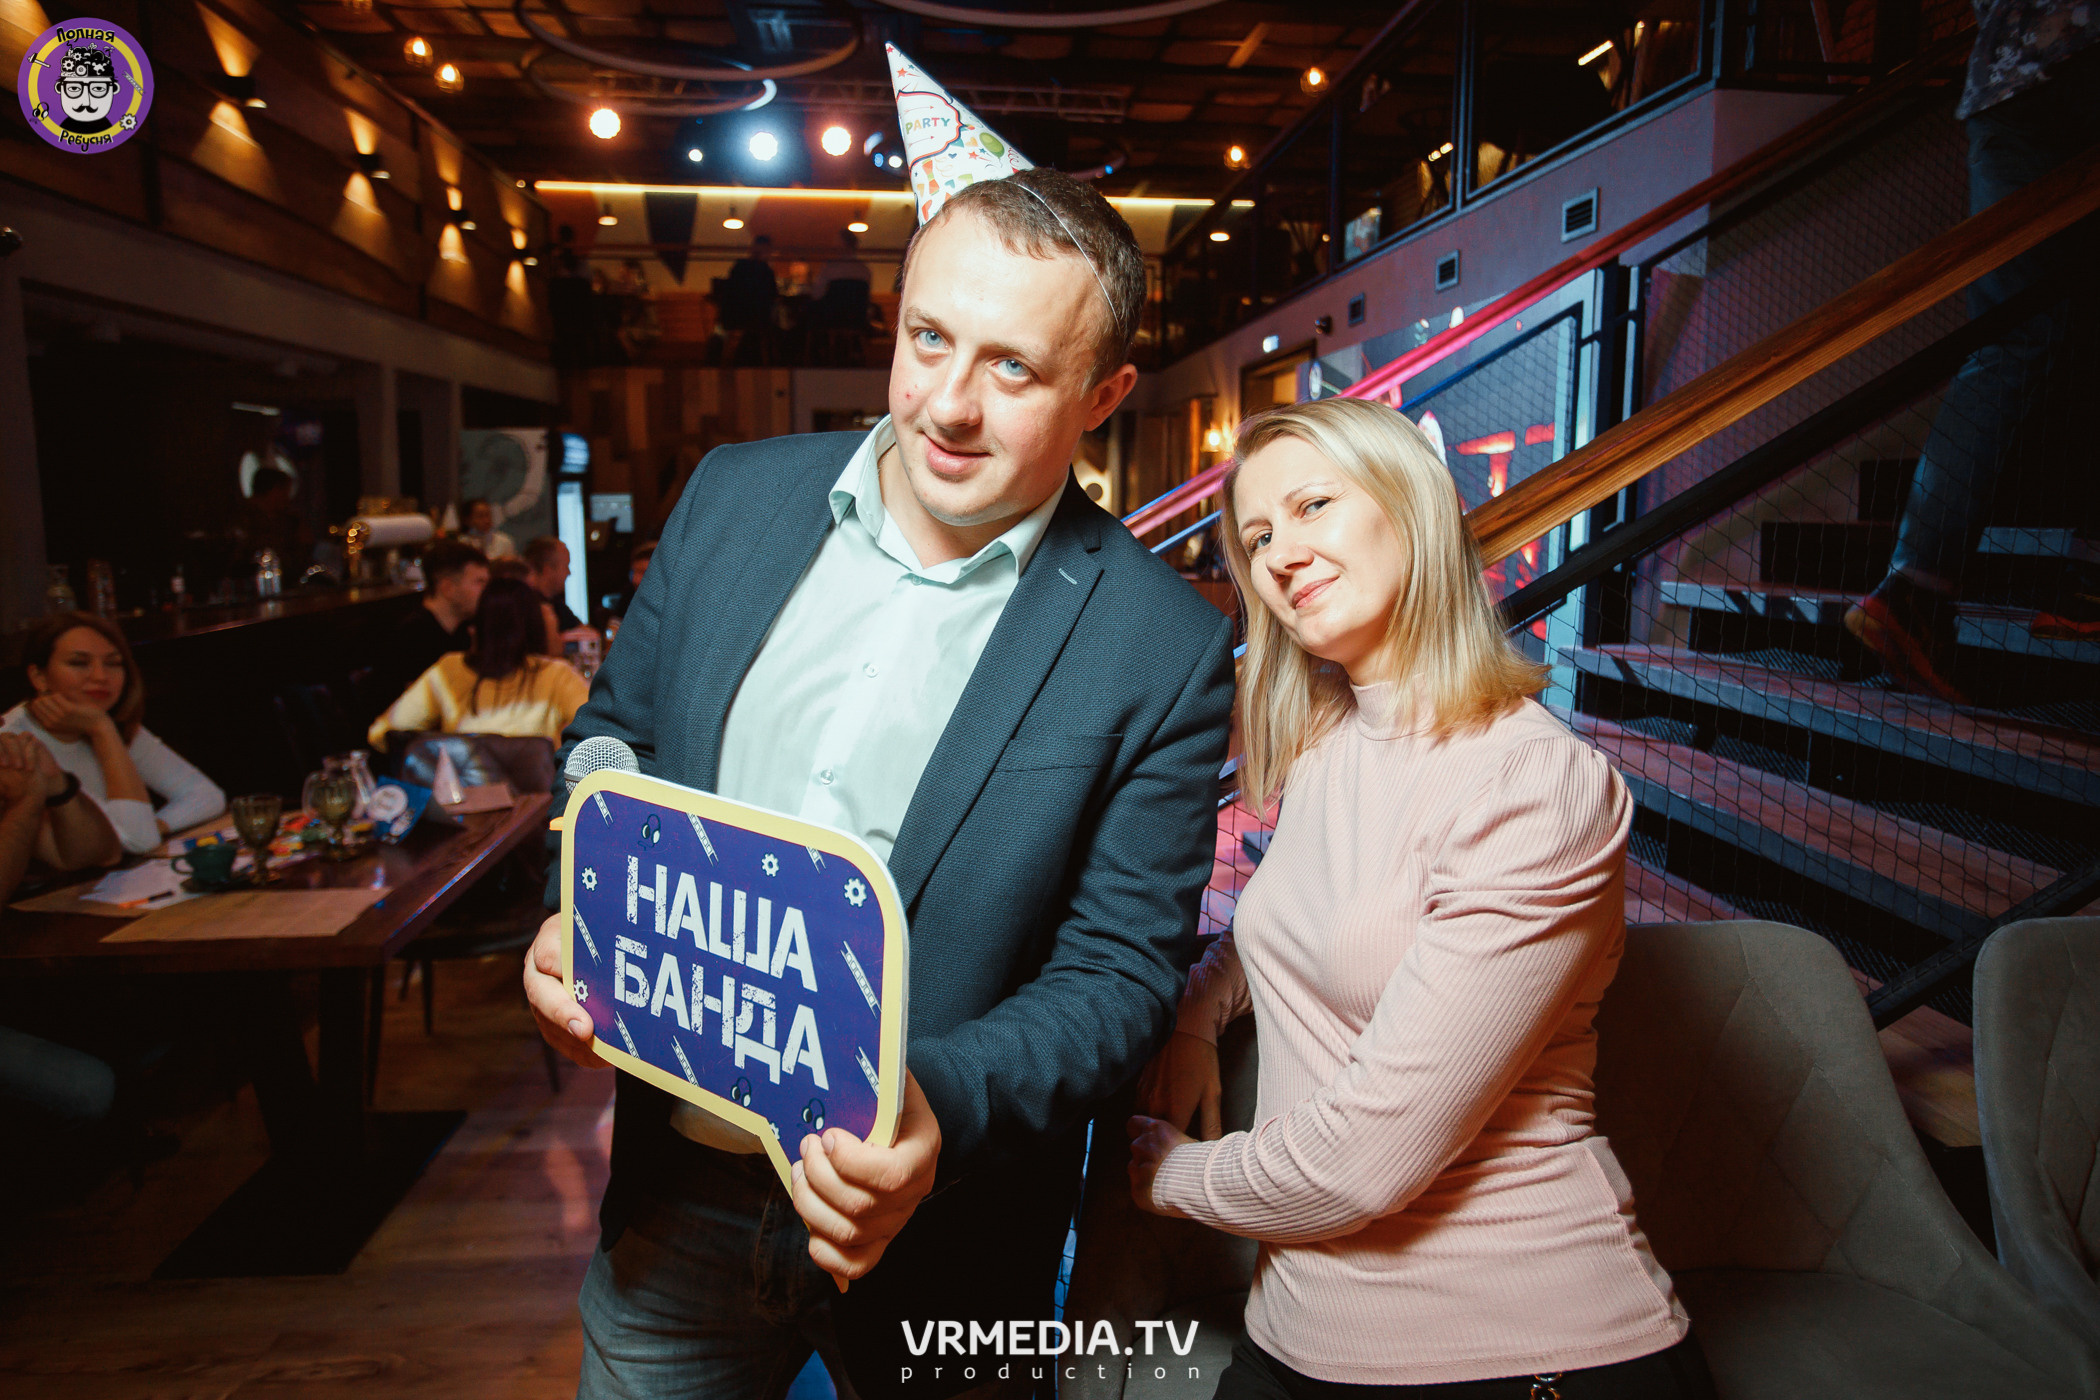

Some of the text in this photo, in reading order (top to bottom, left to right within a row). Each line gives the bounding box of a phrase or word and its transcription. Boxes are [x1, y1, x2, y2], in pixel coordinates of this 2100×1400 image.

[905, 117, 950, 135] PARTY
[626, 854, 819, 992] НАША
[614, 934, 829, 1091] БАНДА
